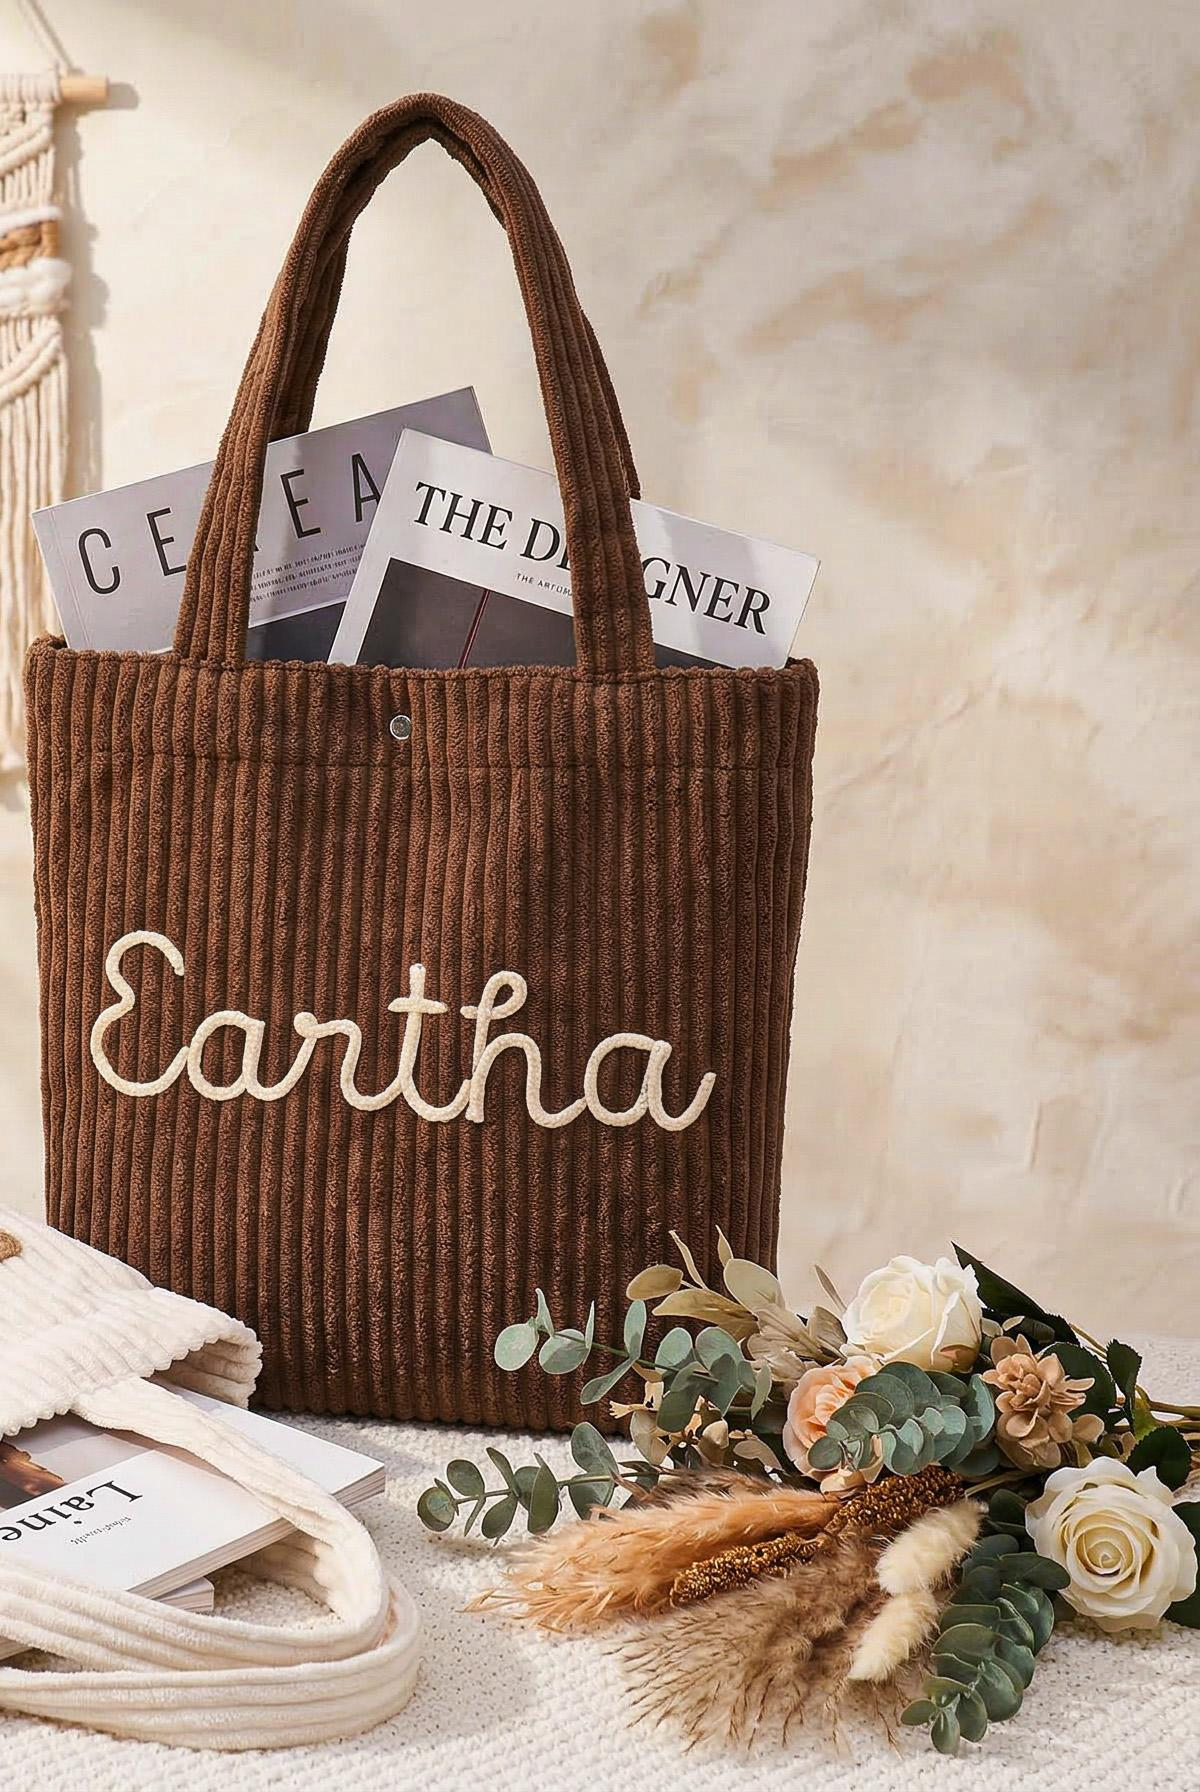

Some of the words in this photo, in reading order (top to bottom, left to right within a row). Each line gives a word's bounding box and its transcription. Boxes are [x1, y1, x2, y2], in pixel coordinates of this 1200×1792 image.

[78, 452, 382, 594] CEEA
[412, 481, 513, 550] THE
[520, 517, 771, 634] DGNER
[516, 573, 534, 585] THE
[90, 930, 717, 1131] Eartha
